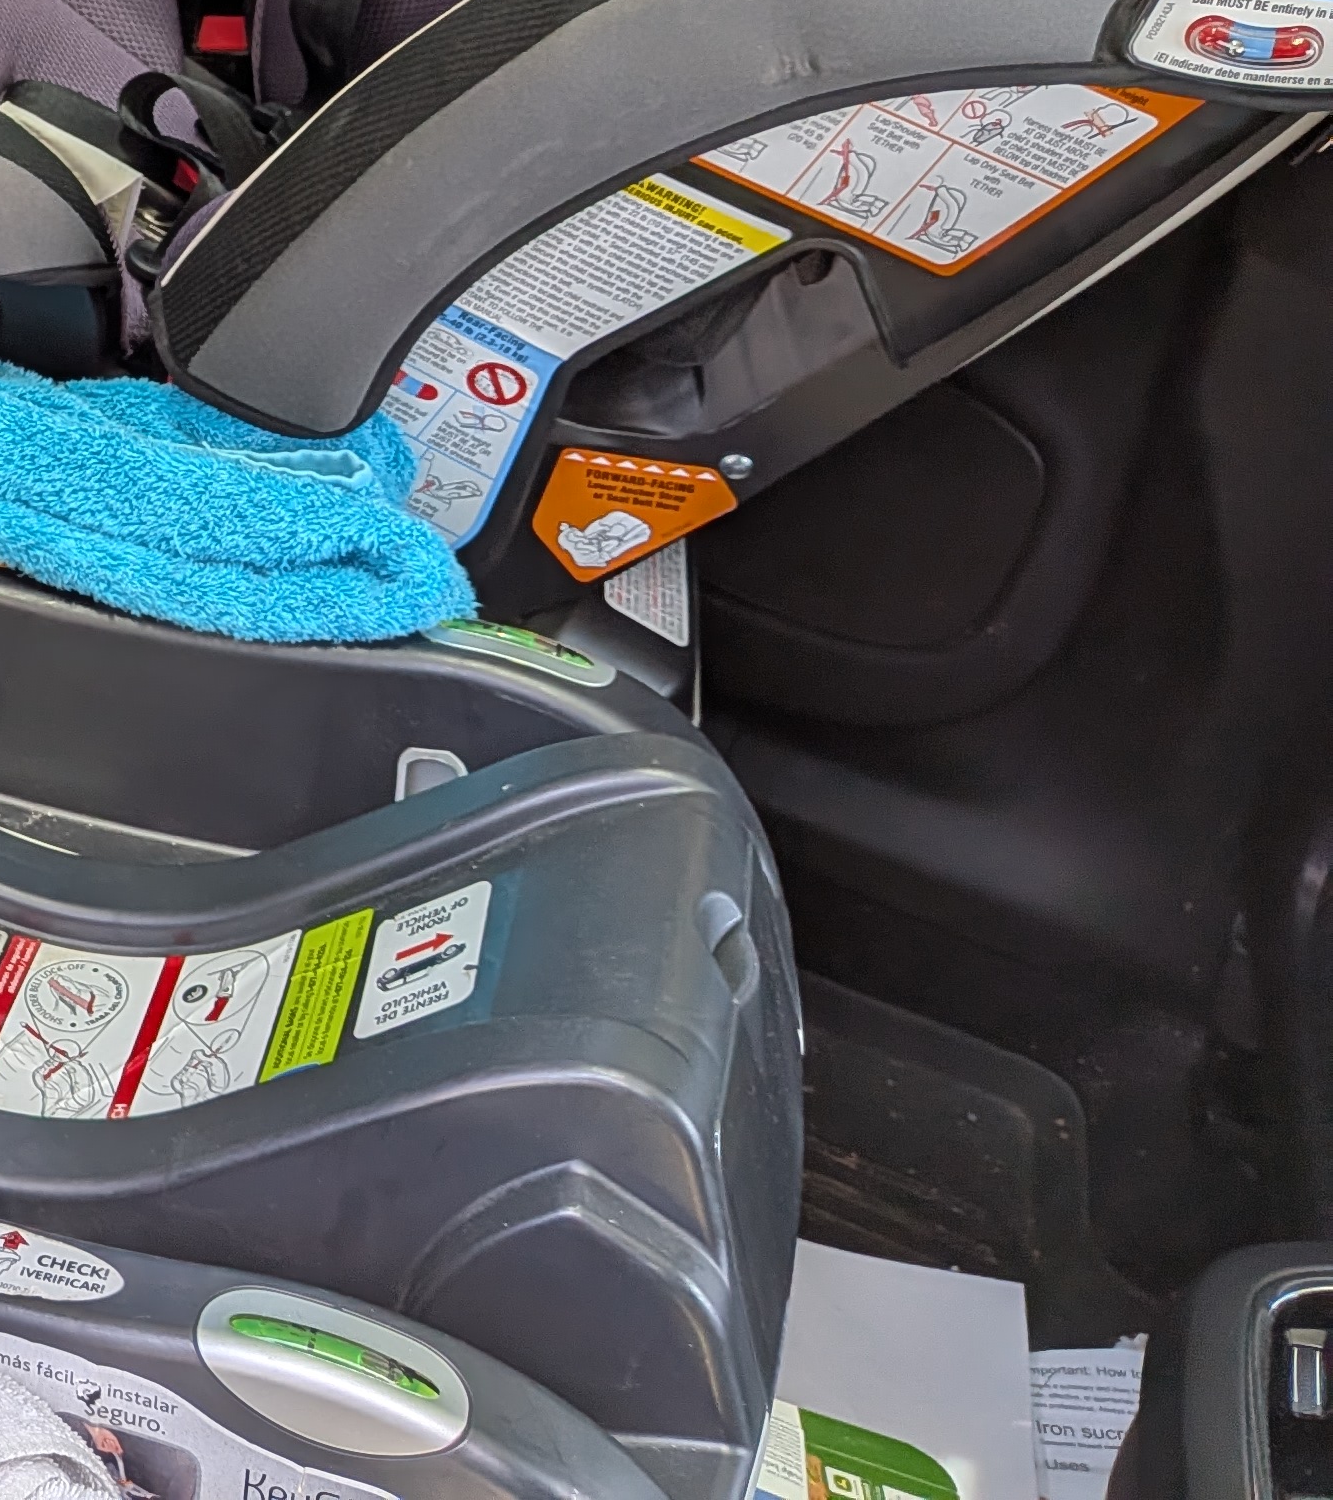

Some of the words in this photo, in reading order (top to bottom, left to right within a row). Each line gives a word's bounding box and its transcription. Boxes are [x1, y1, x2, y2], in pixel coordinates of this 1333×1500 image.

[1253, 0, 1270, 12] BE
[1270, 2, 1314, 18] entirely
[1315, 7, 1326, 18] in
[1215, 66, 1240, 79] debe
[1242, 69, 1305, 88] mantenerse
[1307, 75, 1321, 86] en
[867, 121, 890, 137] Seat
[887, 129, 904, 143] Belt
[902, 136, 920, 150] with
[869, 133, 904, 155] TETHER
[1022, 114, 1052, 134] Harness
[1050, 128, 1073, 146] height
[1071, 136, 1094, 153] MUST
[1093, 146, 1106, 158] BE
[1022, 125, 1035, 137] AT
[1033, 130, 1047, 142] OR
[1044, 135, 1065, 151] JUST
[1063, 143, 1089, 161] ABOVE
[992, 144, 1020, 163] BELOW
[1017, 156, 1032, 170] top
[1006, 129, 1030, 146] child's
[1029, 140, 1063, 160] shoulders
[1062, 154, 1077, 167] and
[1074, 161, 1088, 173] top
[1009, 141, 1032, 158] child's
[1030, 152, 1046, 164] ears
[1045, 157, 1069, 174] MUST
[962, 152, 981, 167] Lap
[979, 159, 999, 175] Only
[999, 168, 1018, 183] Seat
[1016, 176, 1034, 190] Belt
[982, 172, 1001, 186] with
[643, 180, 707, 215] WARNING!
[969, 178, 1003, 199] TETHER
[662, 202, 698, 223] INJURY
[456, 310, 526, 352] Rear-Facing
[585, 468, 695, 492] FORWARD-FACING
[451, 897, 468, 910] OF
[396, 906, 447, 931] VEHICLE
[408, 912, 452, 936] FRONT
[41, 964, 85, 979] LOCK-OFF
[30, 978, 42, 992] BELT
[30, 994, 64, 1025] SHOULDER
[402, 990, 450, 1015] FRENTE
[375, 1011, 397, 1025] DEL
[36, 1253, 109, 1281] CHECK!
[19, 1266, 105, 1294] ¡VERIFICAR!
[1097, 1367, 1126, 1377] How
[35, 1362, 77, 1386] fácil
[105, 1383, 179, 1416] instalar
[1036, 1420, 1075, 1436] Iron
[1045, 1459, 1089, 1471] Uses
